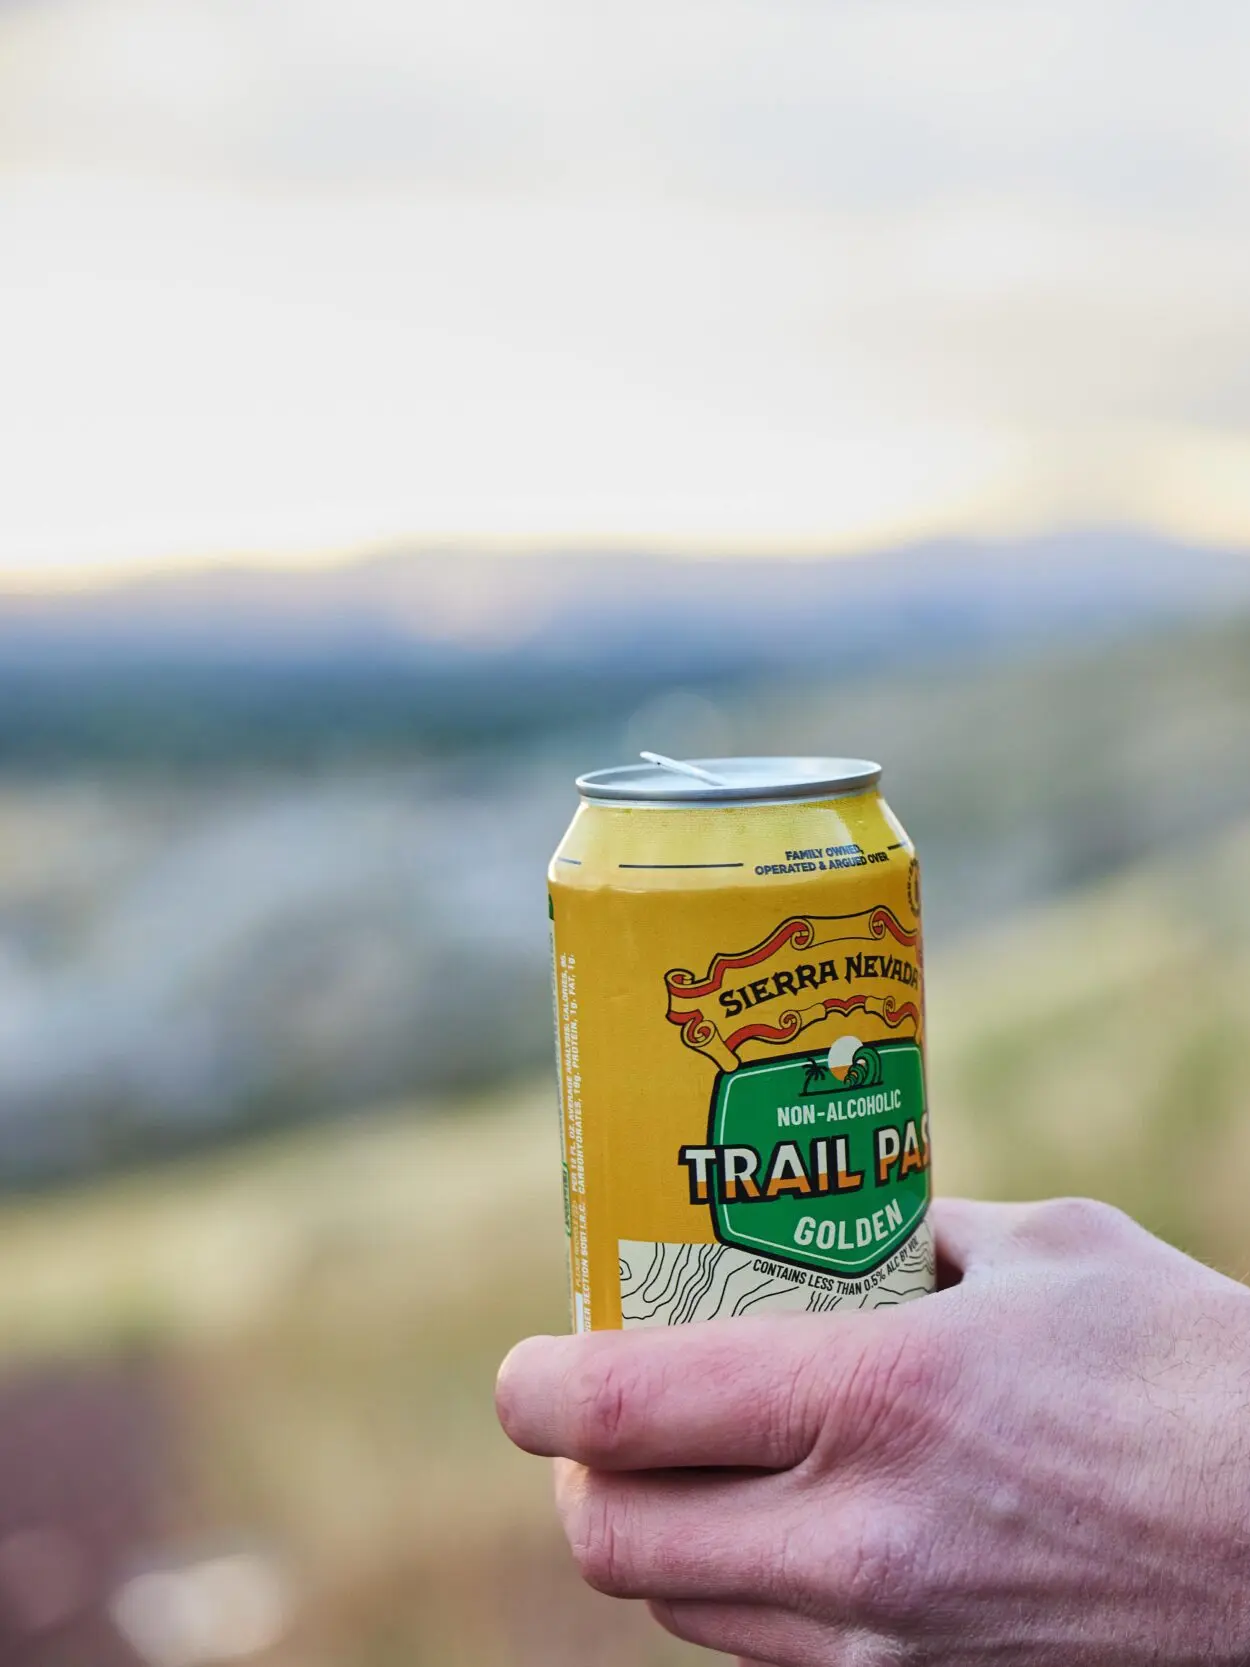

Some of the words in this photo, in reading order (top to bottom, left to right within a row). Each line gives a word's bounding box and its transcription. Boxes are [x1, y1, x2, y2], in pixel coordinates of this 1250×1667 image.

[755, 861, 817, 875] OPERATED
[819, 860, 827, 870] &
[829, 855, 868, 870] ARGUED
[867, 851, 890, 864] OVER
[785, 848, 823, 861] FAMILY
[718, 960, 838, 1018] SIERRA
[844, 952, 920, 991] NEVADA
[570, 1018, 580, 1068] PROTEIN,
[566, 1075, 575, 1121] AVERAGE
[777, 1089, 902, 1127] NON-ALCOHOLIC
[574, 1098, 586, 1195] CARBOHYDRATES,
[680, 1136, 864, 1203] TRAIL
[794, 1199, 904, 1250] GOLDEN
[581, 1259, 591, 1305] SECTION
[752, 1259, 806, 1285] CONTAINS
[808, 1273, 835, 1291] LESS
[836, 1281, 862, 1295] THAN
[863, 1269, 886, 1292] 0.5%
[886, 1256, 900, 1275] ALC
[899, 1246, 908, 1262] BY
